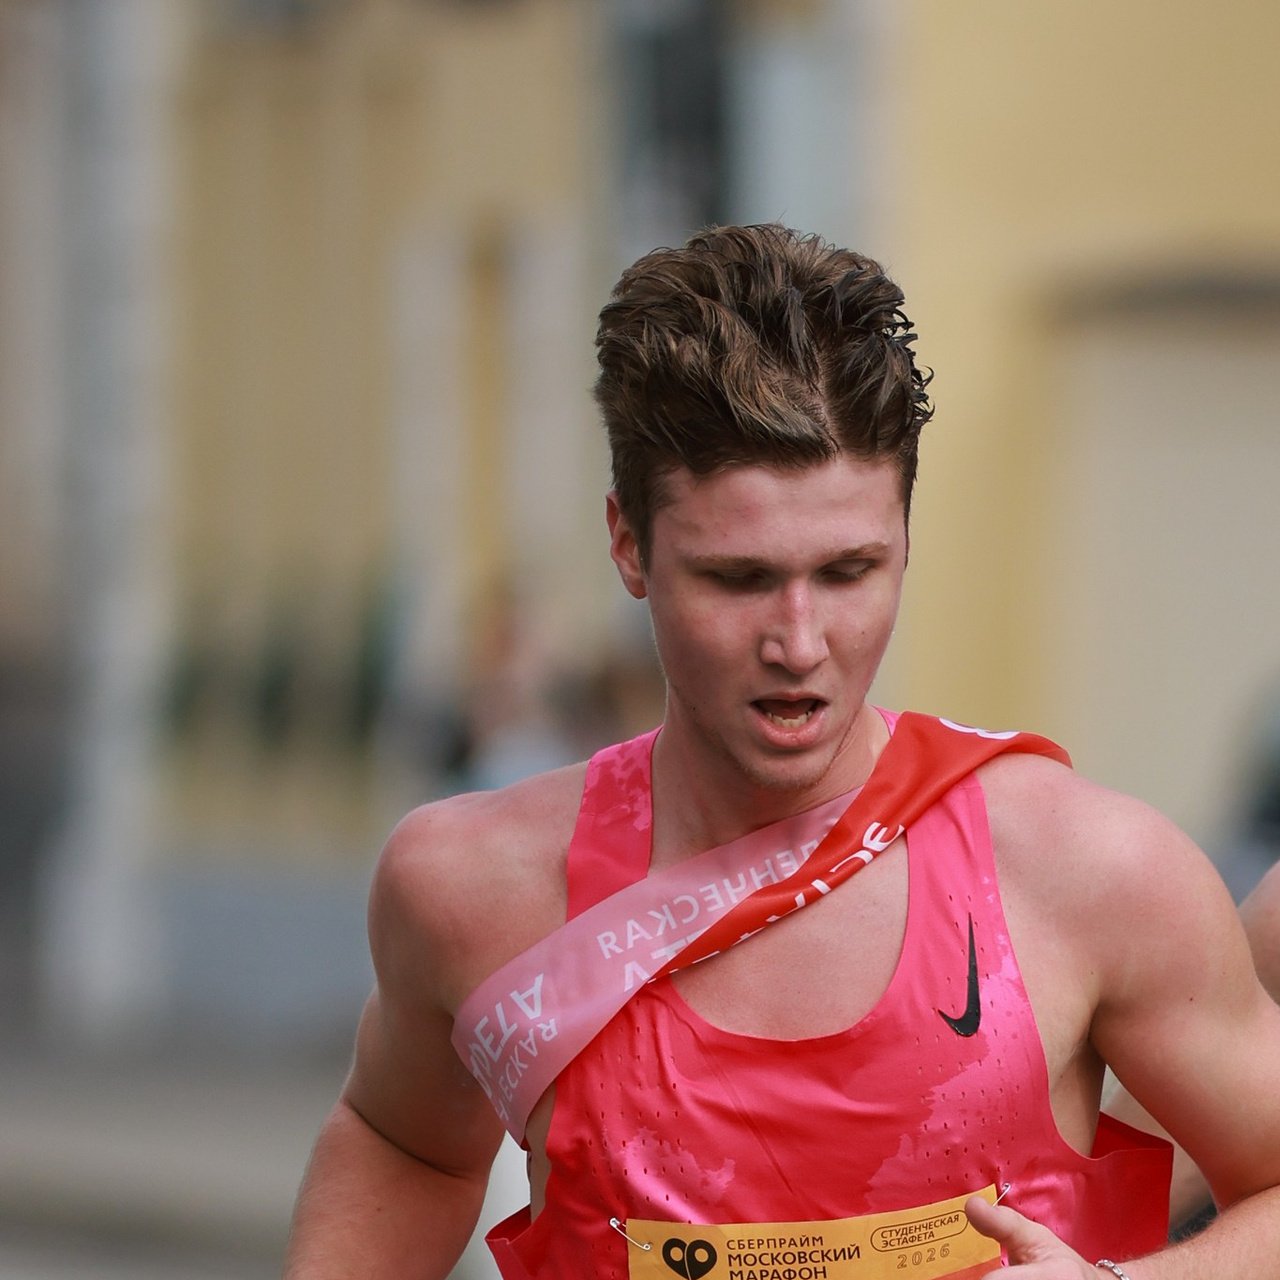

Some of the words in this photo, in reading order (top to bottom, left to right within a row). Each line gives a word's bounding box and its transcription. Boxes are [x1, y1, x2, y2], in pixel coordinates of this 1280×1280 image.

[880, 1213, 960, 1239] СТУДЕНЧЕСКАЯ
[727, 1234, 824, 1250] СБЕРПРАЙМ
[881, 1230, 935, 1248] ЭСТАФЕТА
[728, 1244, 861, 1267] МОСКОВСКИЙ
[897, 1243, 950, 1269] 2026
